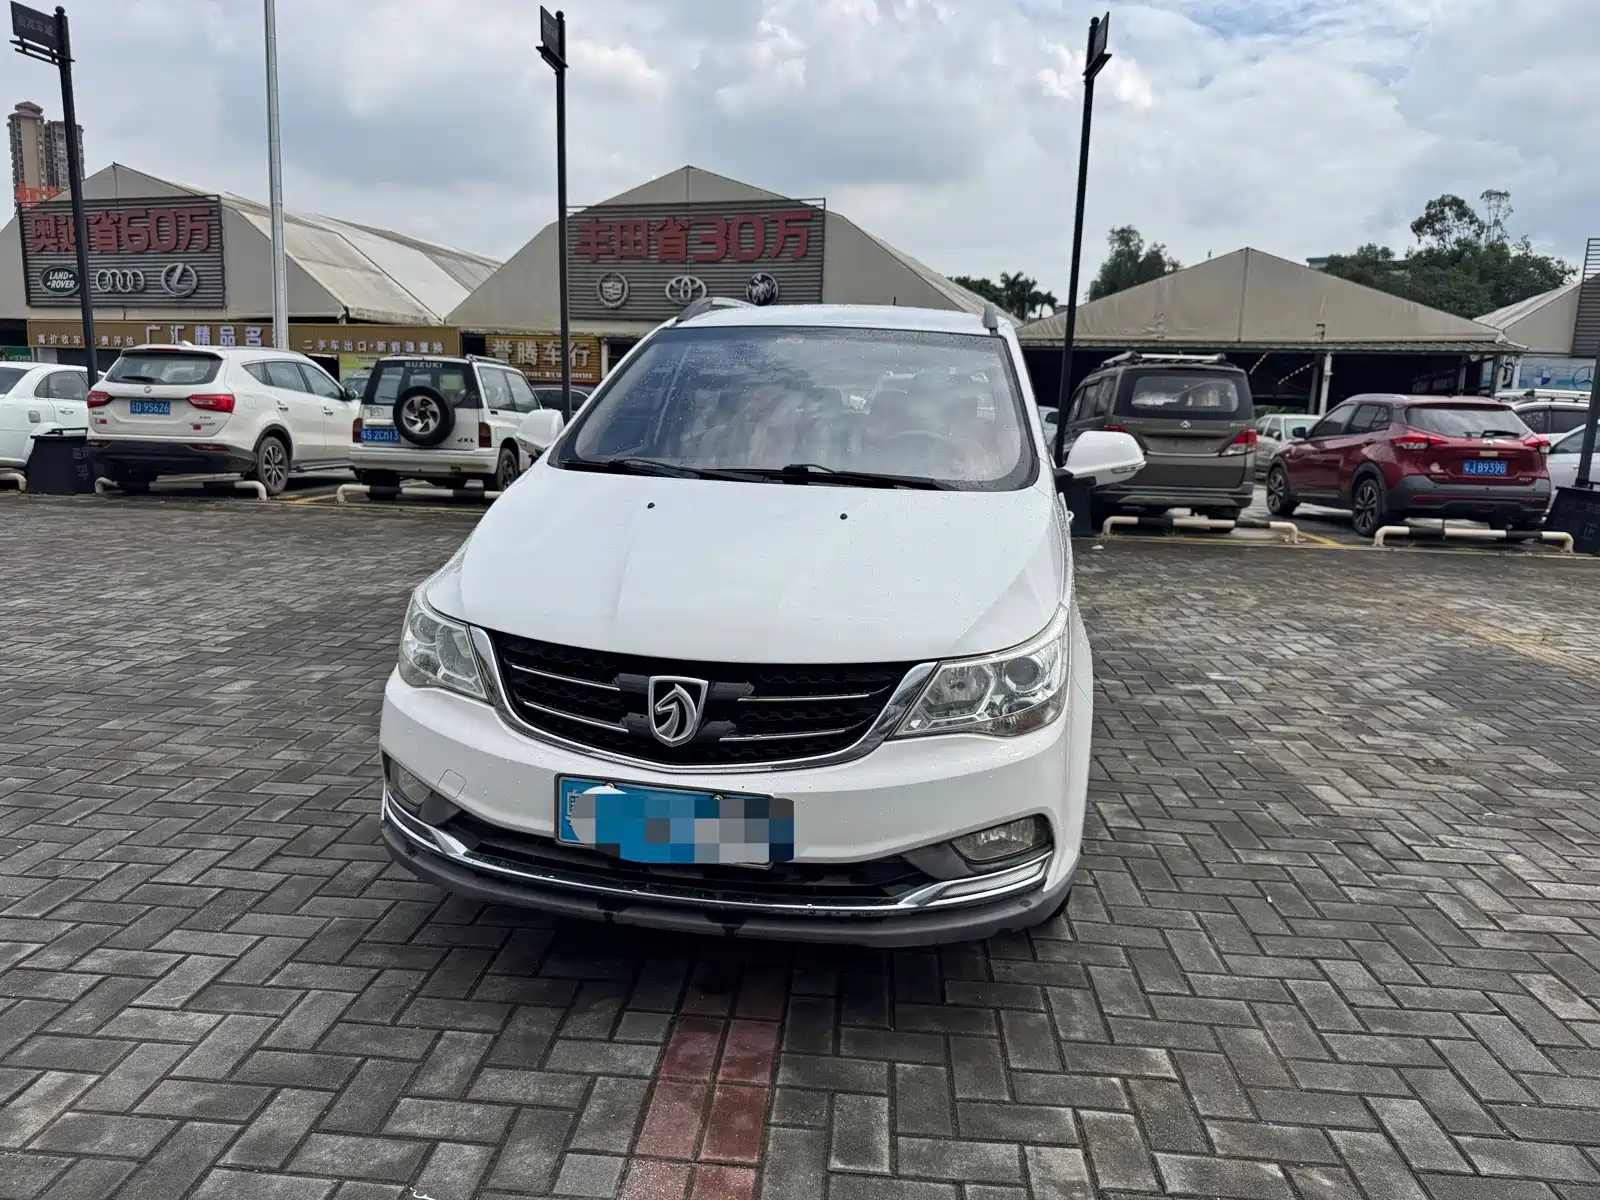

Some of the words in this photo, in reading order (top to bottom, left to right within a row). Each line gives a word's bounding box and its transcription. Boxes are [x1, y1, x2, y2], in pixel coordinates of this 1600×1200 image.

[573, 211, 813, 263] 丰田省30万
[49, 271, 69, 280] LAND
[50, 280, 75, 289] ROVER
[145, 324, 275, 347] 广汇精品名
[404, 361, 443, 369] SUZUKI
